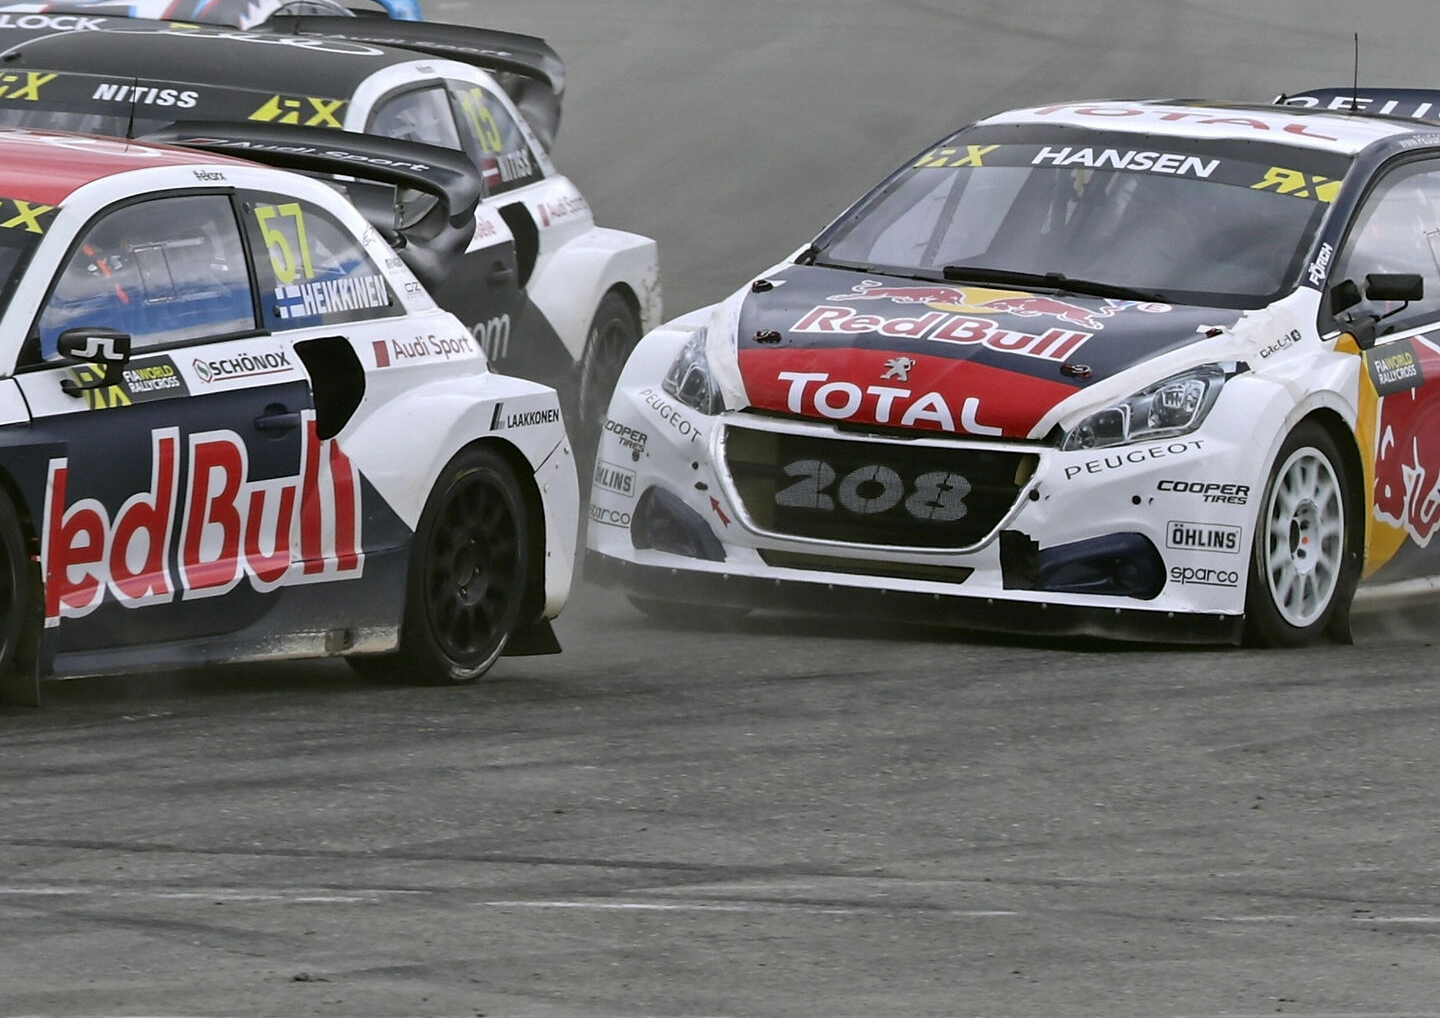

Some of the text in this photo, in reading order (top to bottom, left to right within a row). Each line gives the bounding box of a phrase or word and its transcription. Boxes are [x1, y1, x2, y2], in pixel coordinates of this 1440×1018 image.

[92, 83, 200, 109] NITISS
[1032, 146, 1220, 178] HANSEN
[254, 202, 315, 283] 57
[301, 274, 389, 316] HEIKKINEN
[393, 333, 474, 360] Audi Sport
[789, 305, 1095, 362] Red Bull
[210, 351, 291, 375] SCHÖNOX
[639, 388, 702, 443] PEUGEOT
[777, 371, 1003, 436] TOTAL
[507, 409, 560, 430] LAAKKONEN
[1064, 439, 1205, 481] PEUGEOT
[774, 458, 972, 522] 208
[1157, 480, 1251, 498] COOPER
[1203, 494, 1248, 505] TIRES
[1172, 523, 1237, 549] ÖHLINS
[1170, 566, 1239, 586] sparco
